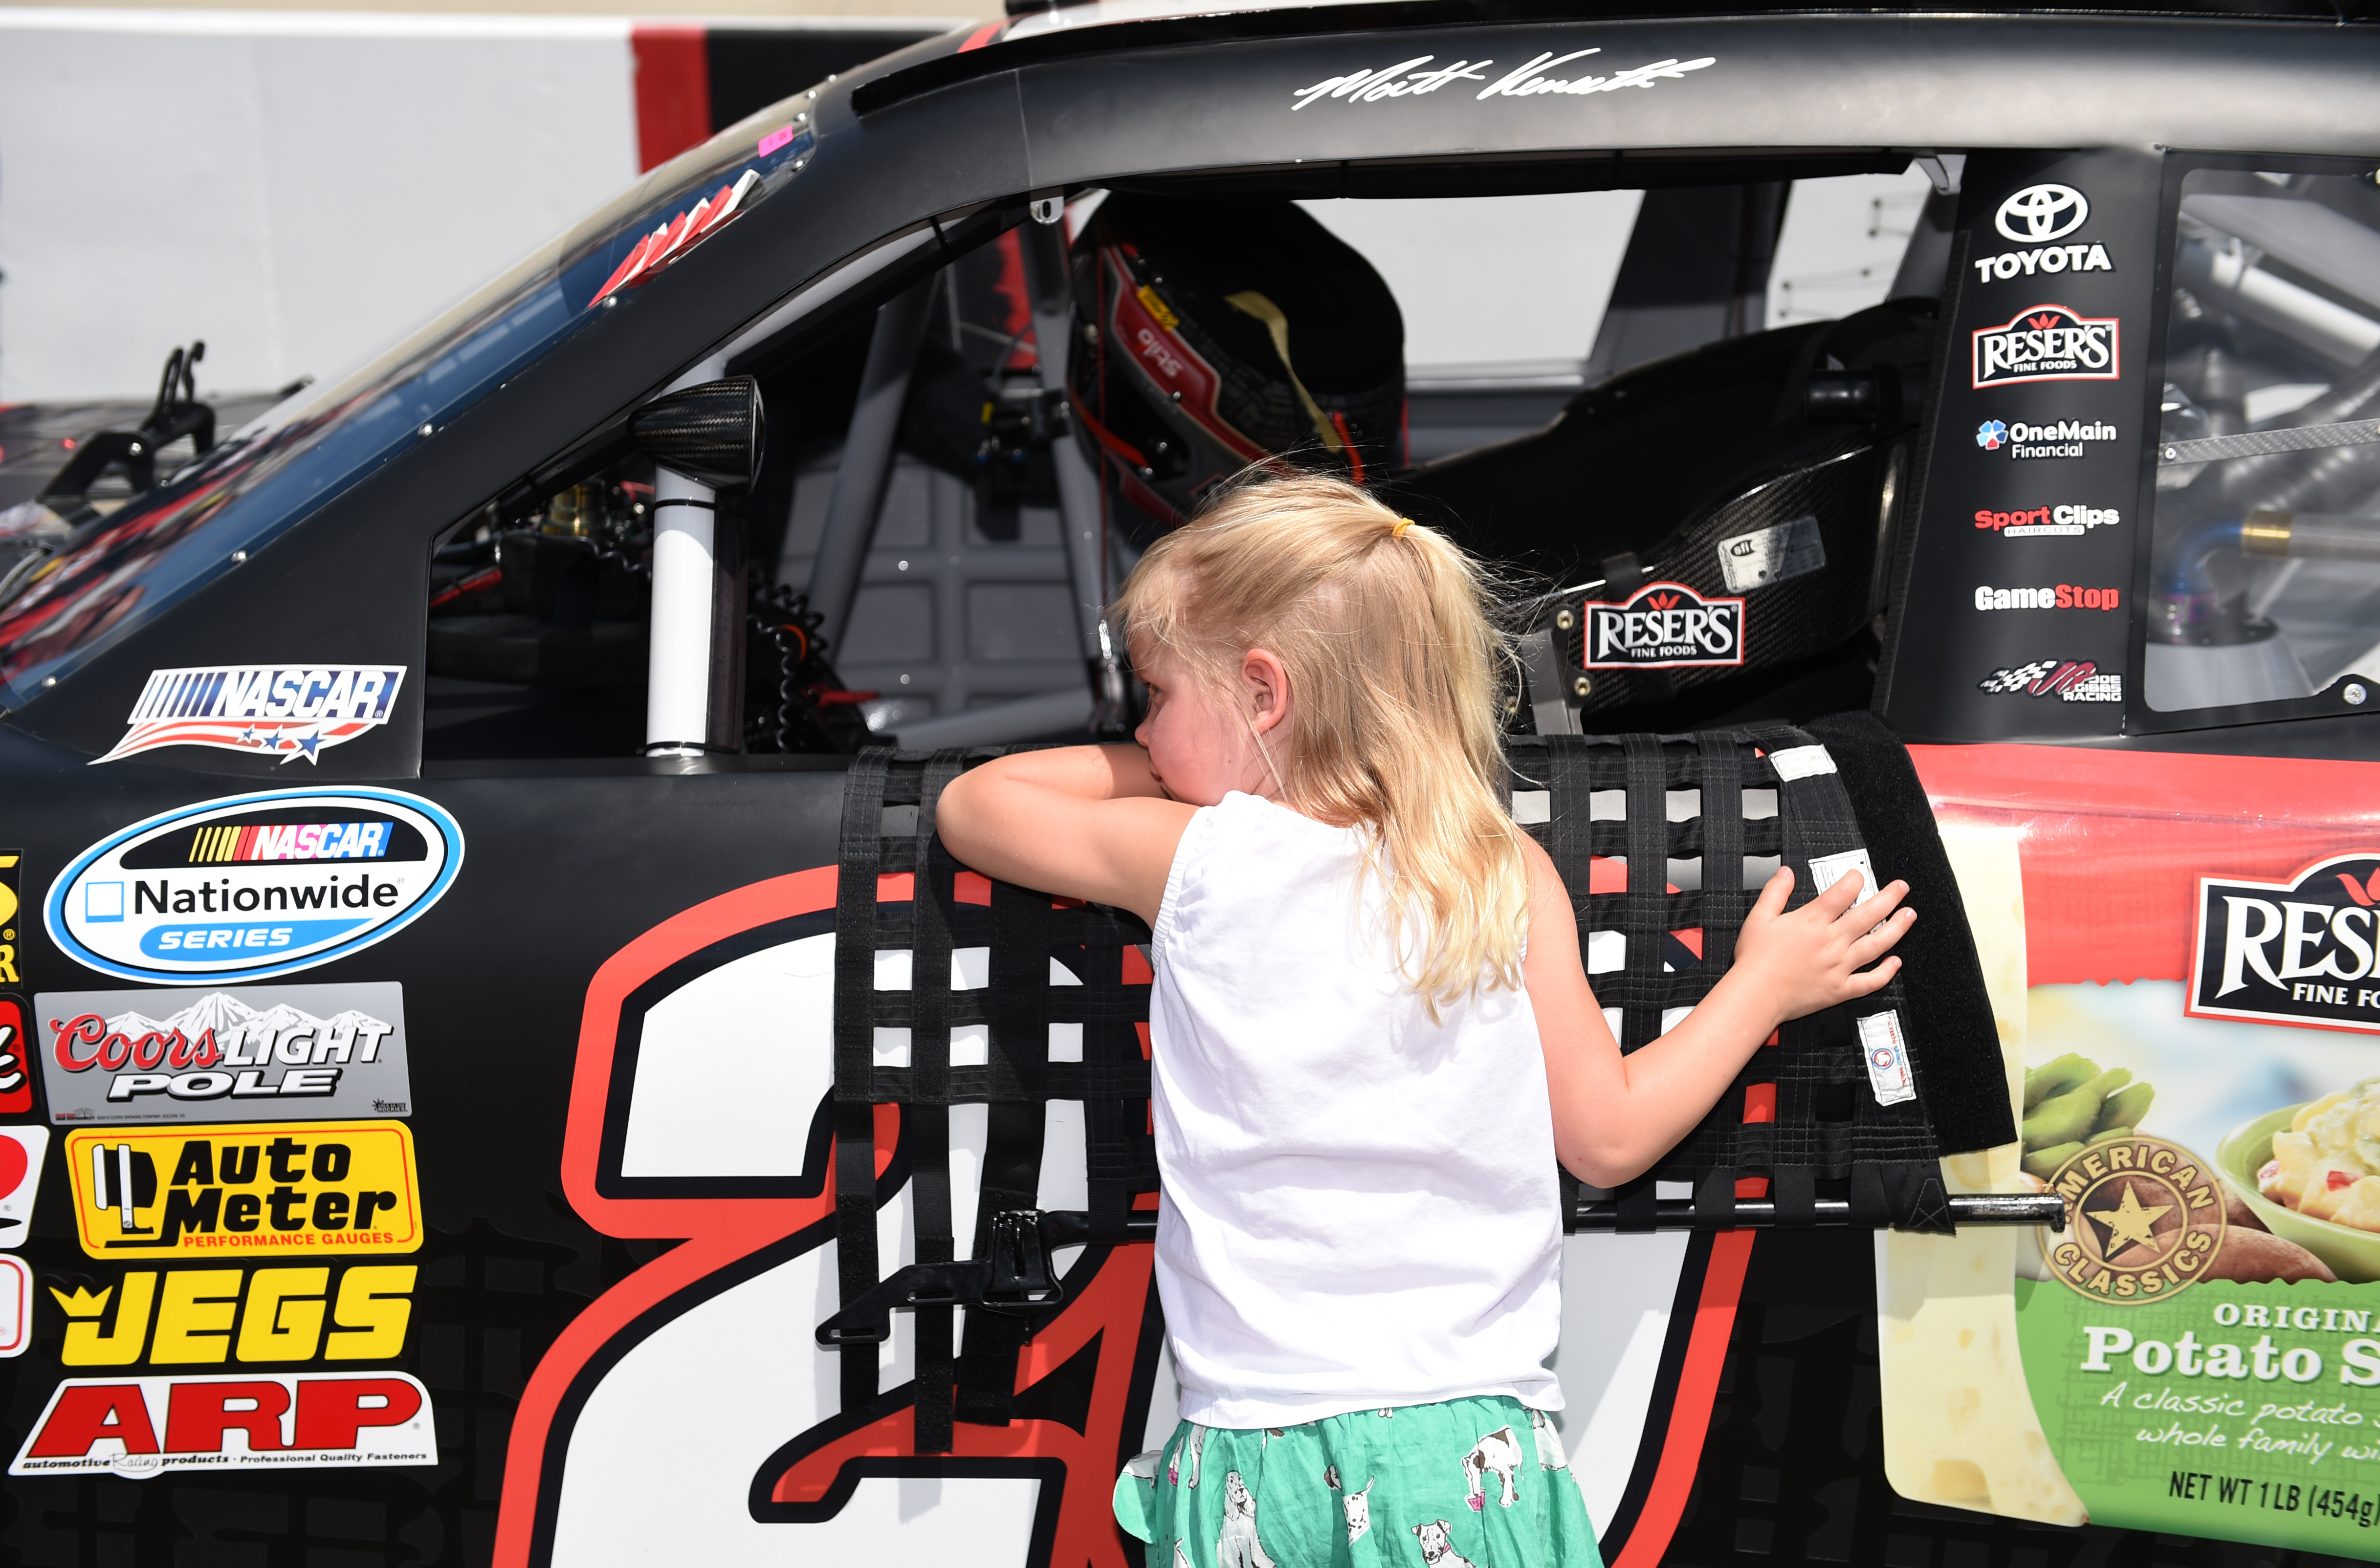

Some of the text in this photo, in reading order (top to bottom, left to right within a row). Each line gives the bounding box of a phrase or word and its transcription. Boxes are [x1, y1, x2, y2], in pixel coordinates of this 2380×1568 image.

[1975, 244, 2112, 283] TOYOTA
[1983, 325, 2110, 379] RESER'S
[2013, 360, 2077, 373] FINE FOODS
[2010, 421, 2117, 441] OneMain
[2012, 443, 2083, 458] Financial
[2007, 525, 2082, 535] HAIRCUTS
[1975, 584, 2120, 611] GameStop
[1596, 605, 1734, 660] RESER'S
[1631, 645, 1697, 658] FINE FOODS
[213, 670, 384, 719] NASCAR
[2063, 692, 2122, 701] RACING
[2074, 684, 2121, 693] GIBBS
[2088, 675, 2121, 684] JOE
[250, 822, 383, 860] NASCAR
[134, 874, 399, 915] Nationwide
[157, 927, 293, 951] SERIES
[2292, 983, 2348, 1006] FINE
[48, 1012, 223, 1071] Coors
[222, 1024, 394, 1067] LIGHT
[106, 1068, 343, 1102] POLE
[170, 1137, 352, 1186] Auto
[165, 1186, 397, 1234] Meter
[183, 1231, 394, 1248] PERFORMANCE GAUGES
[2054, 1230, 2212, 1297] CLASSICS
[61, 1265, 419, 1366] JEGS
[2213, 1303, 2380, 1334] ORIGIN
[2080, 1326, 2323, 1382] Potato
[25, 1378, 423, 1459] ARP
[2101, 1381, 2127, 1408] A
[2134, 1387, 2247, 1417] classic
[2250, 1399, 2364, 1426] potato
[22, 1452, 427, 1473] automotive Racing products Professional Quality Fasteners
[2136, 1424, 2227, 1448] whole
[2239, 1428, 2334, 1465] family
[2168, 1470, 2212, 1501] NET
[2219, 1476, 2254, 1507] WT
[2260, 1482, 2269, 1509] 1
[2273, 1483, 2301, 1512] LB
